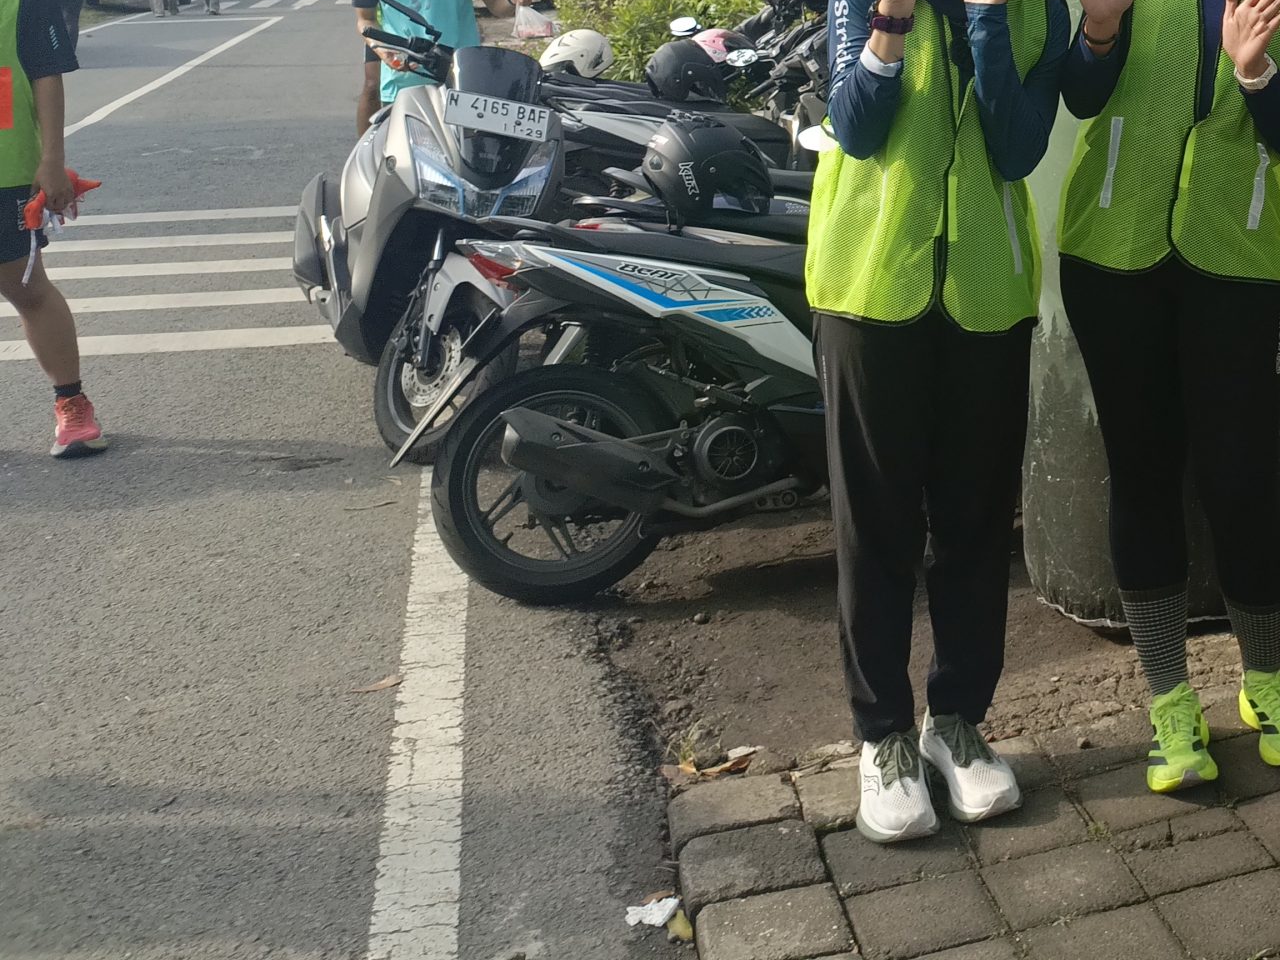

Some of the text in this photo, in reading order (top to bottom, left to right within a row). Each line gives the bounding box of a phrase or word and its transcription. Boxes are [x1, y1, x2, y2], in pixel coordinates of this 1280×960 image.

[449, 92, 547, 124] N 4165 BAF
